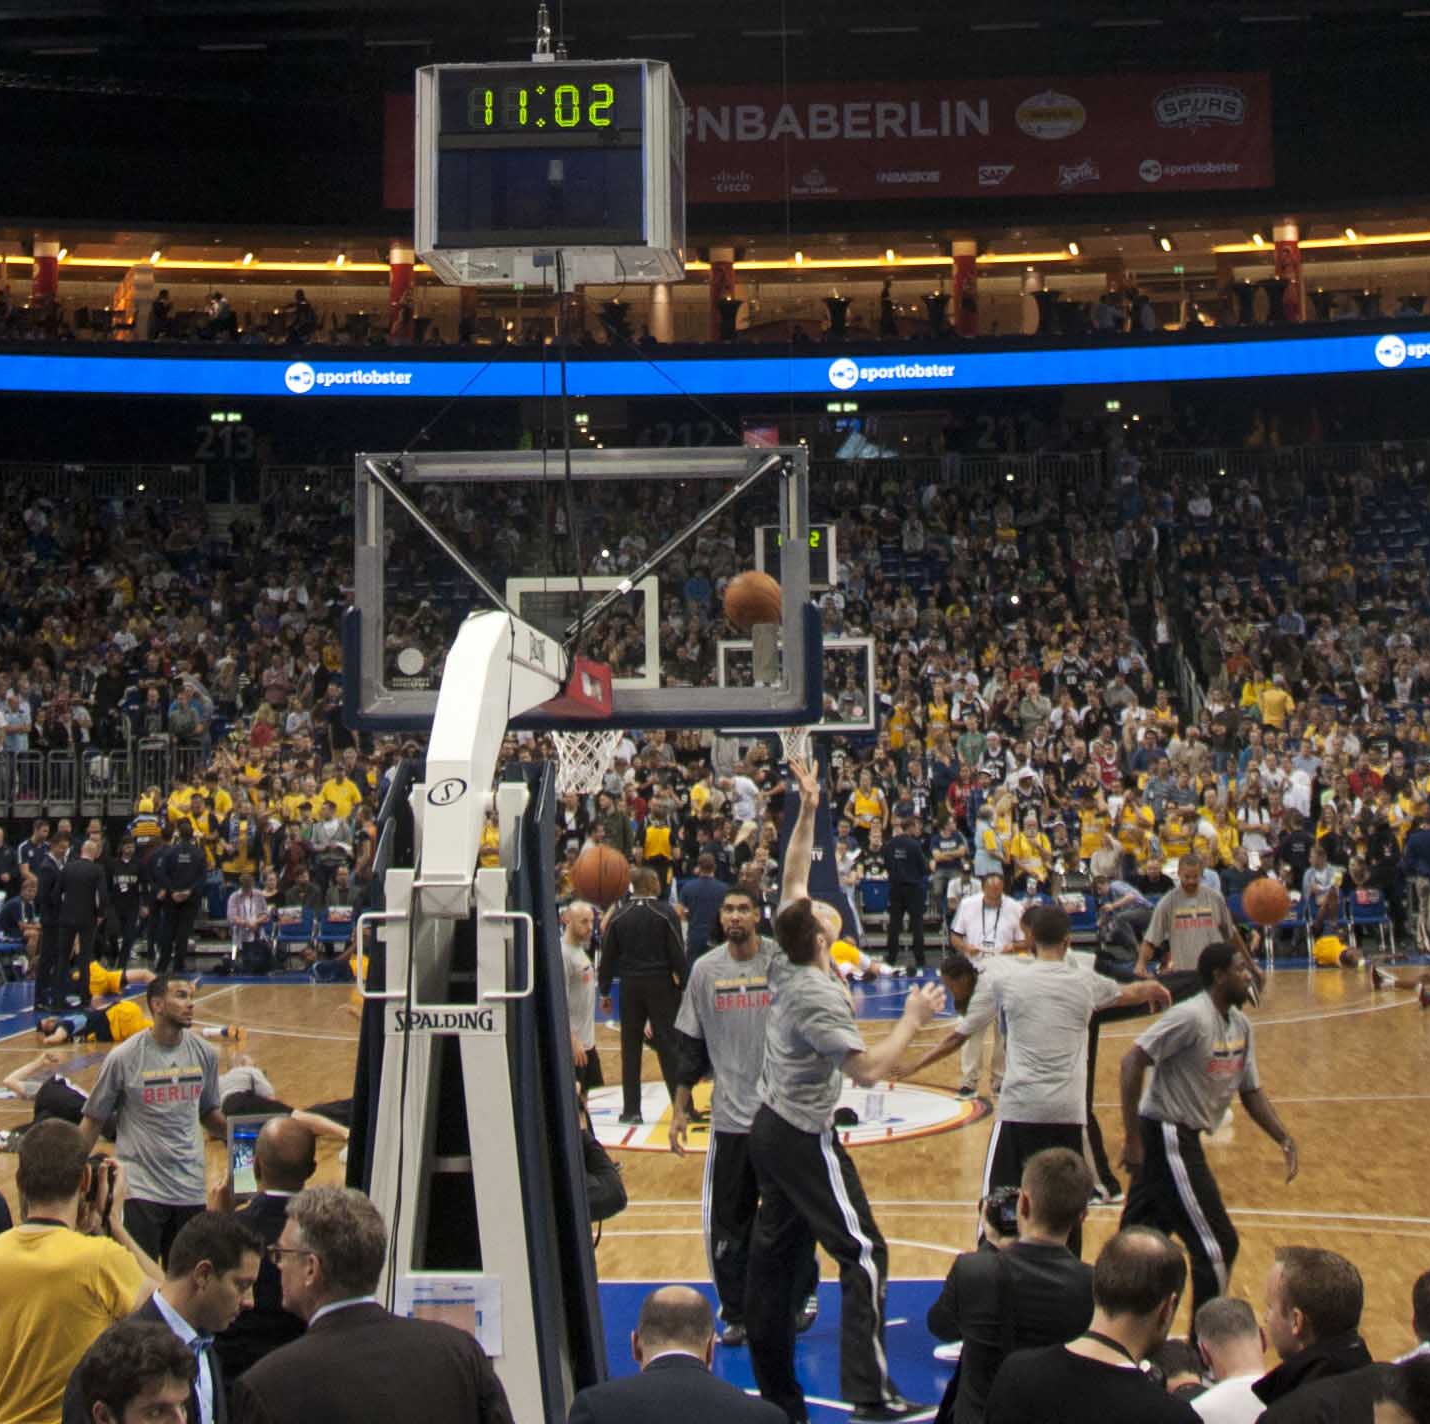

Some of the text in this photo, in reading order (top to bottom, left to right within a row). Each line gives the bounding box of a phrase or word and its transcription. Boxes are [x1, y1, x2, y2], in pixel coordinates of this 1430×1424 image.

[483, 83, 615, 127] 11:02
[1163, 96, 1237, 117] SPURS
[1163, 161, 1242, 176] sportlobster
[317, 369, 410, 387] sportlobster
[860, 362, 953, 380] sportlobster
[194, 424, 255, 459] 213
[395, 1007, 494, 1033] SPALDING
[142, 1085, 203, 1106] BERLIN
